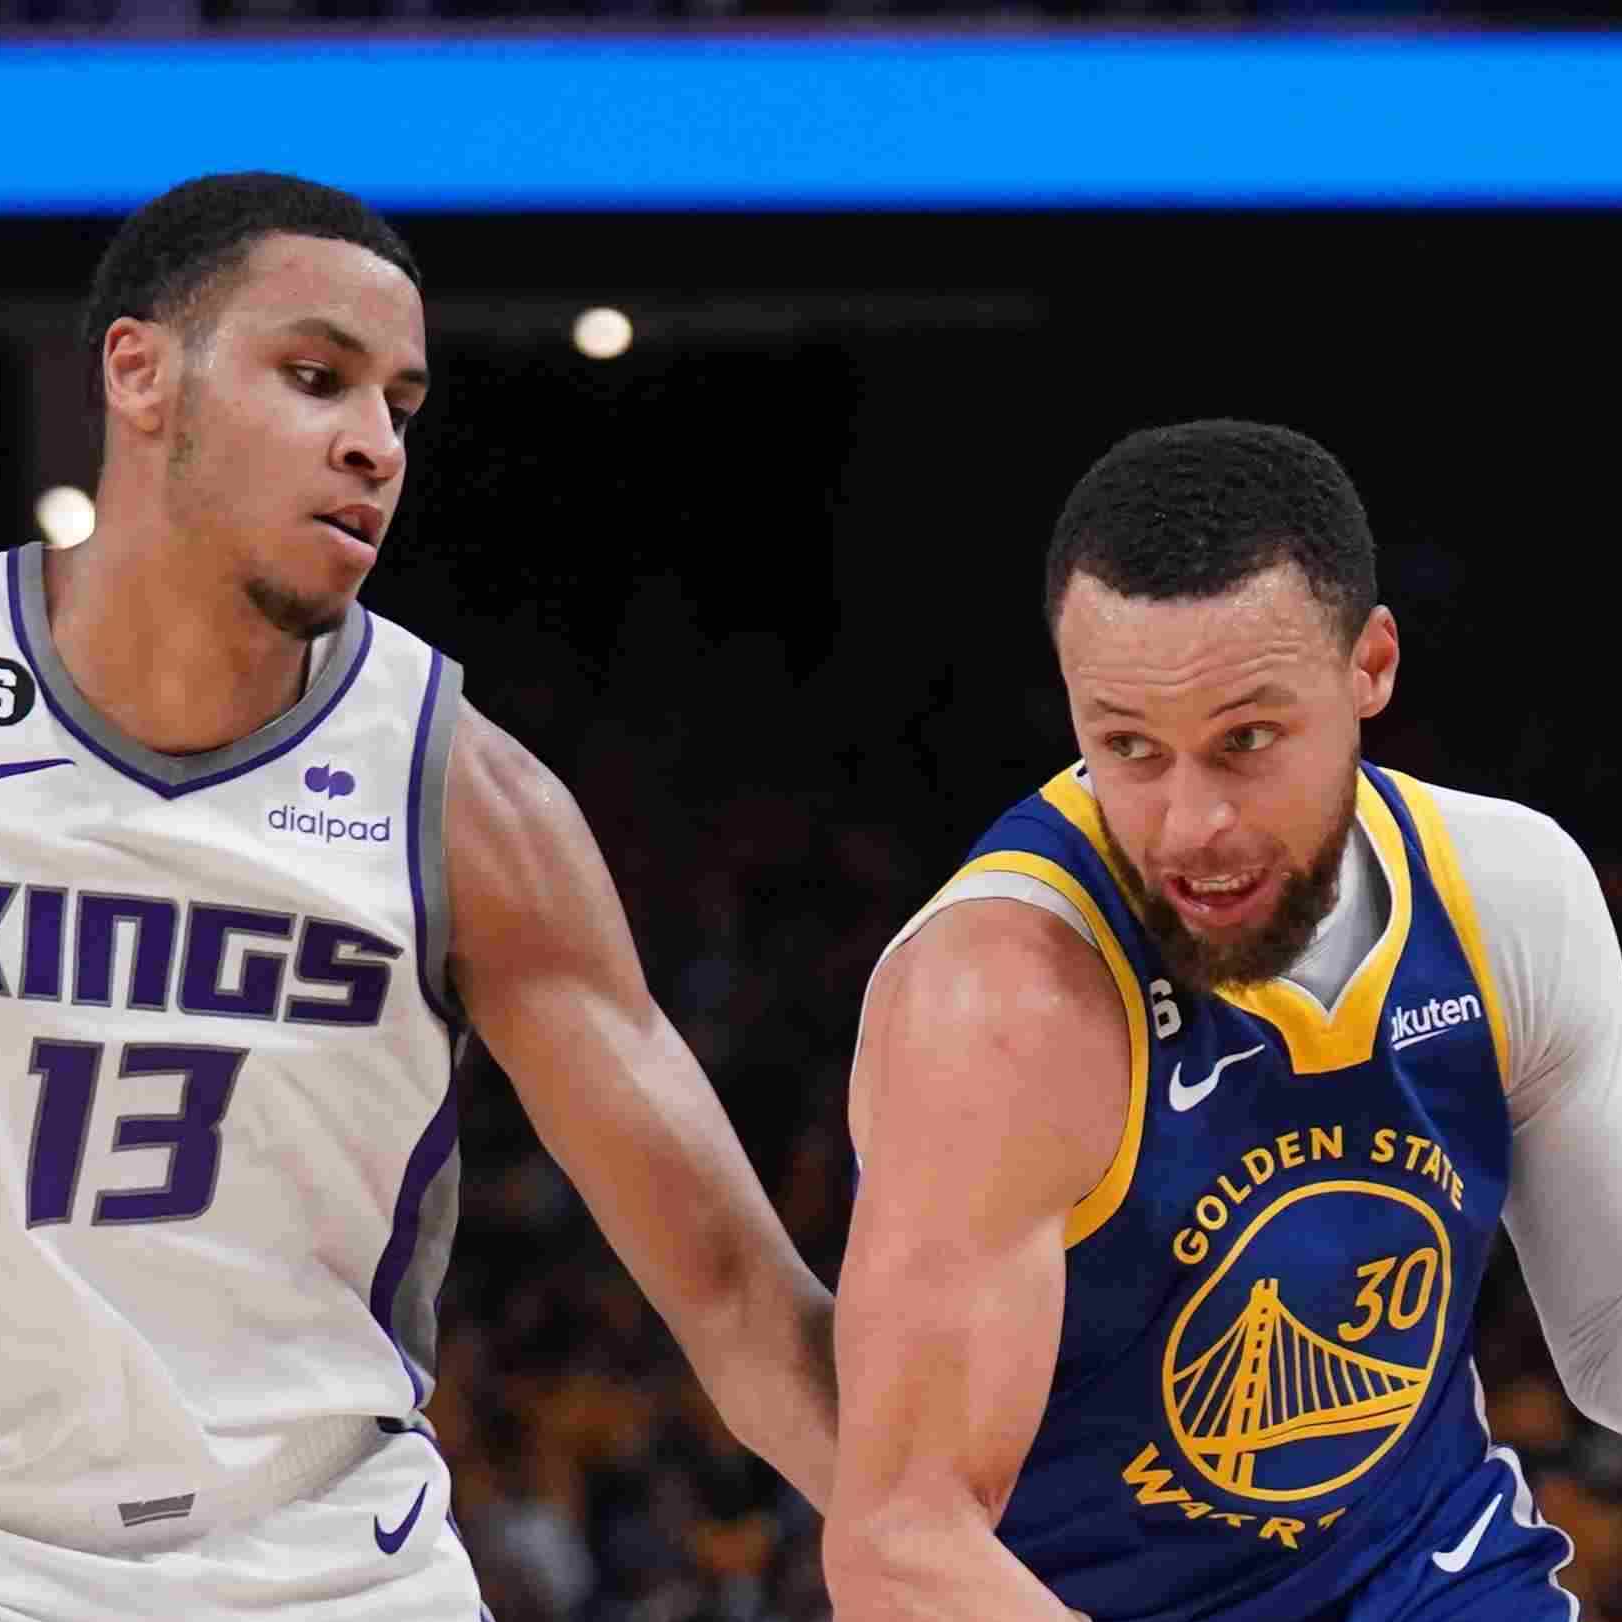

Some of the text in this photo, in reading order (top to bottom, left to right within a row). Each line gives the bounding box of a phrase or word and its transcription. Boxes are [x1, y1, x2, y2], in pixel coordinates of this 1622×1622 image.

[268, 805, 391, 843] dialpad
[26, 1036, 250, 1231] 13
[1173, 1125, 1464, 1264] GOLDEN STATE
[1338, 1247, 1438, 1342] 30
